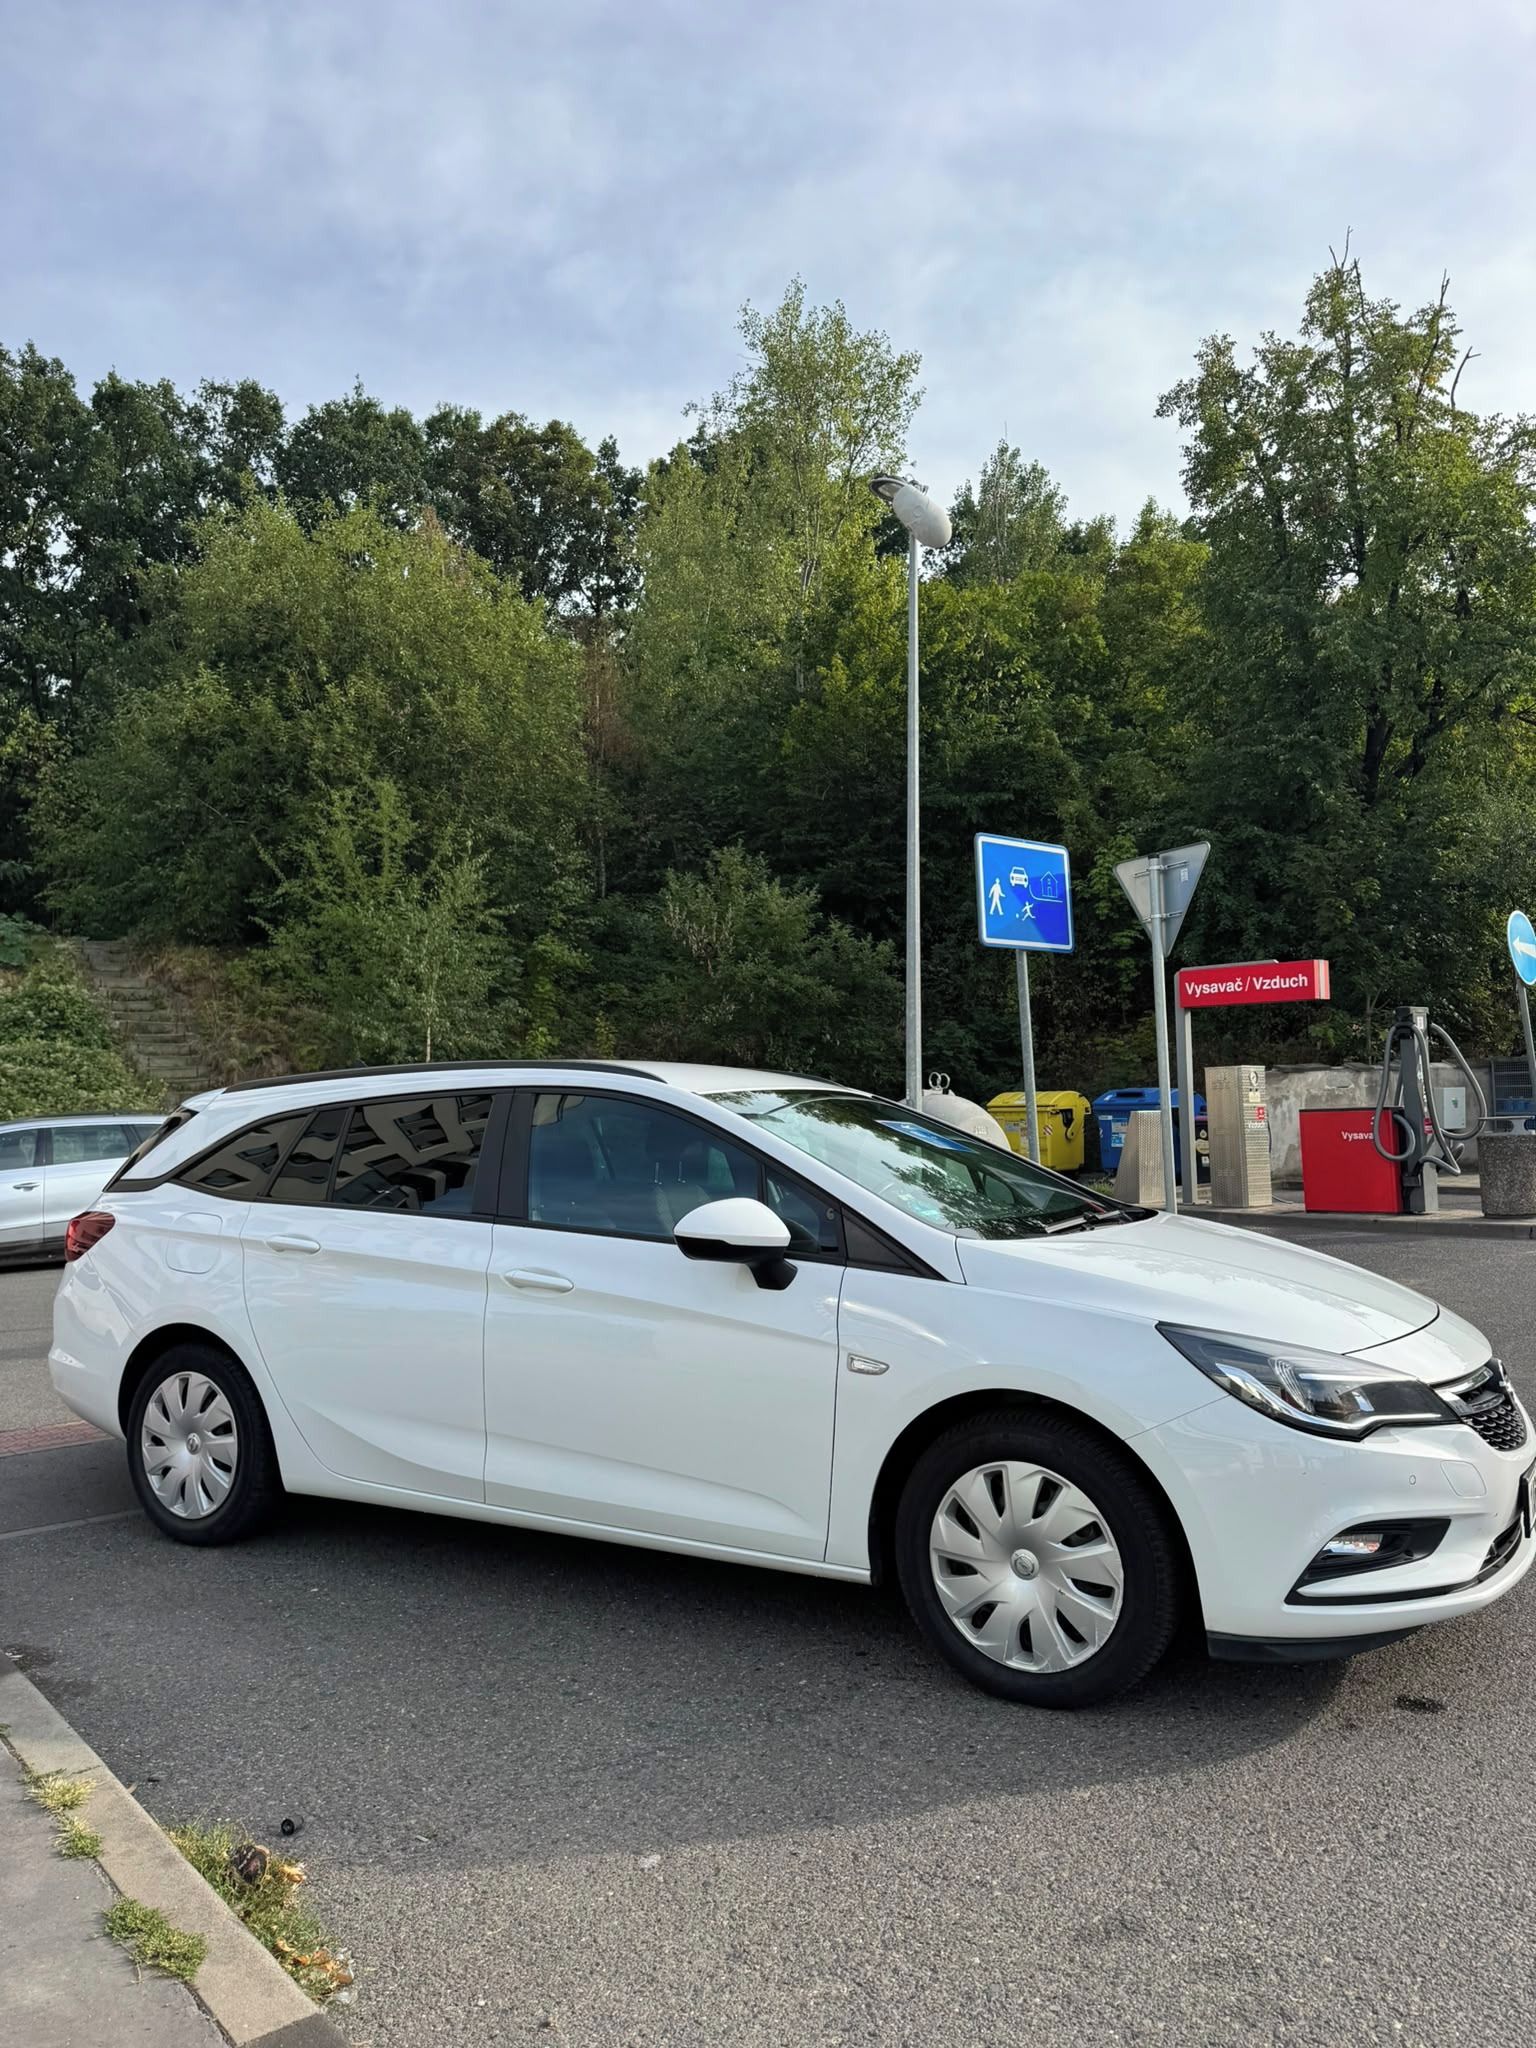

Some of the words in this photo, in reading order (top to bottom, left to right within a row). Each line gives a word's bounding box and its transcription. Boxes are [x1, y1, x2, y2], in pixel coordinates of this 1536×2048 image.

[1185, 977, 1243, 998] Vysavač
[1245, 976, 1250, 991] /
[1253, 974, 1308, 990] Vzduch
[1341, 1131, 1374, 1142] Vysava
